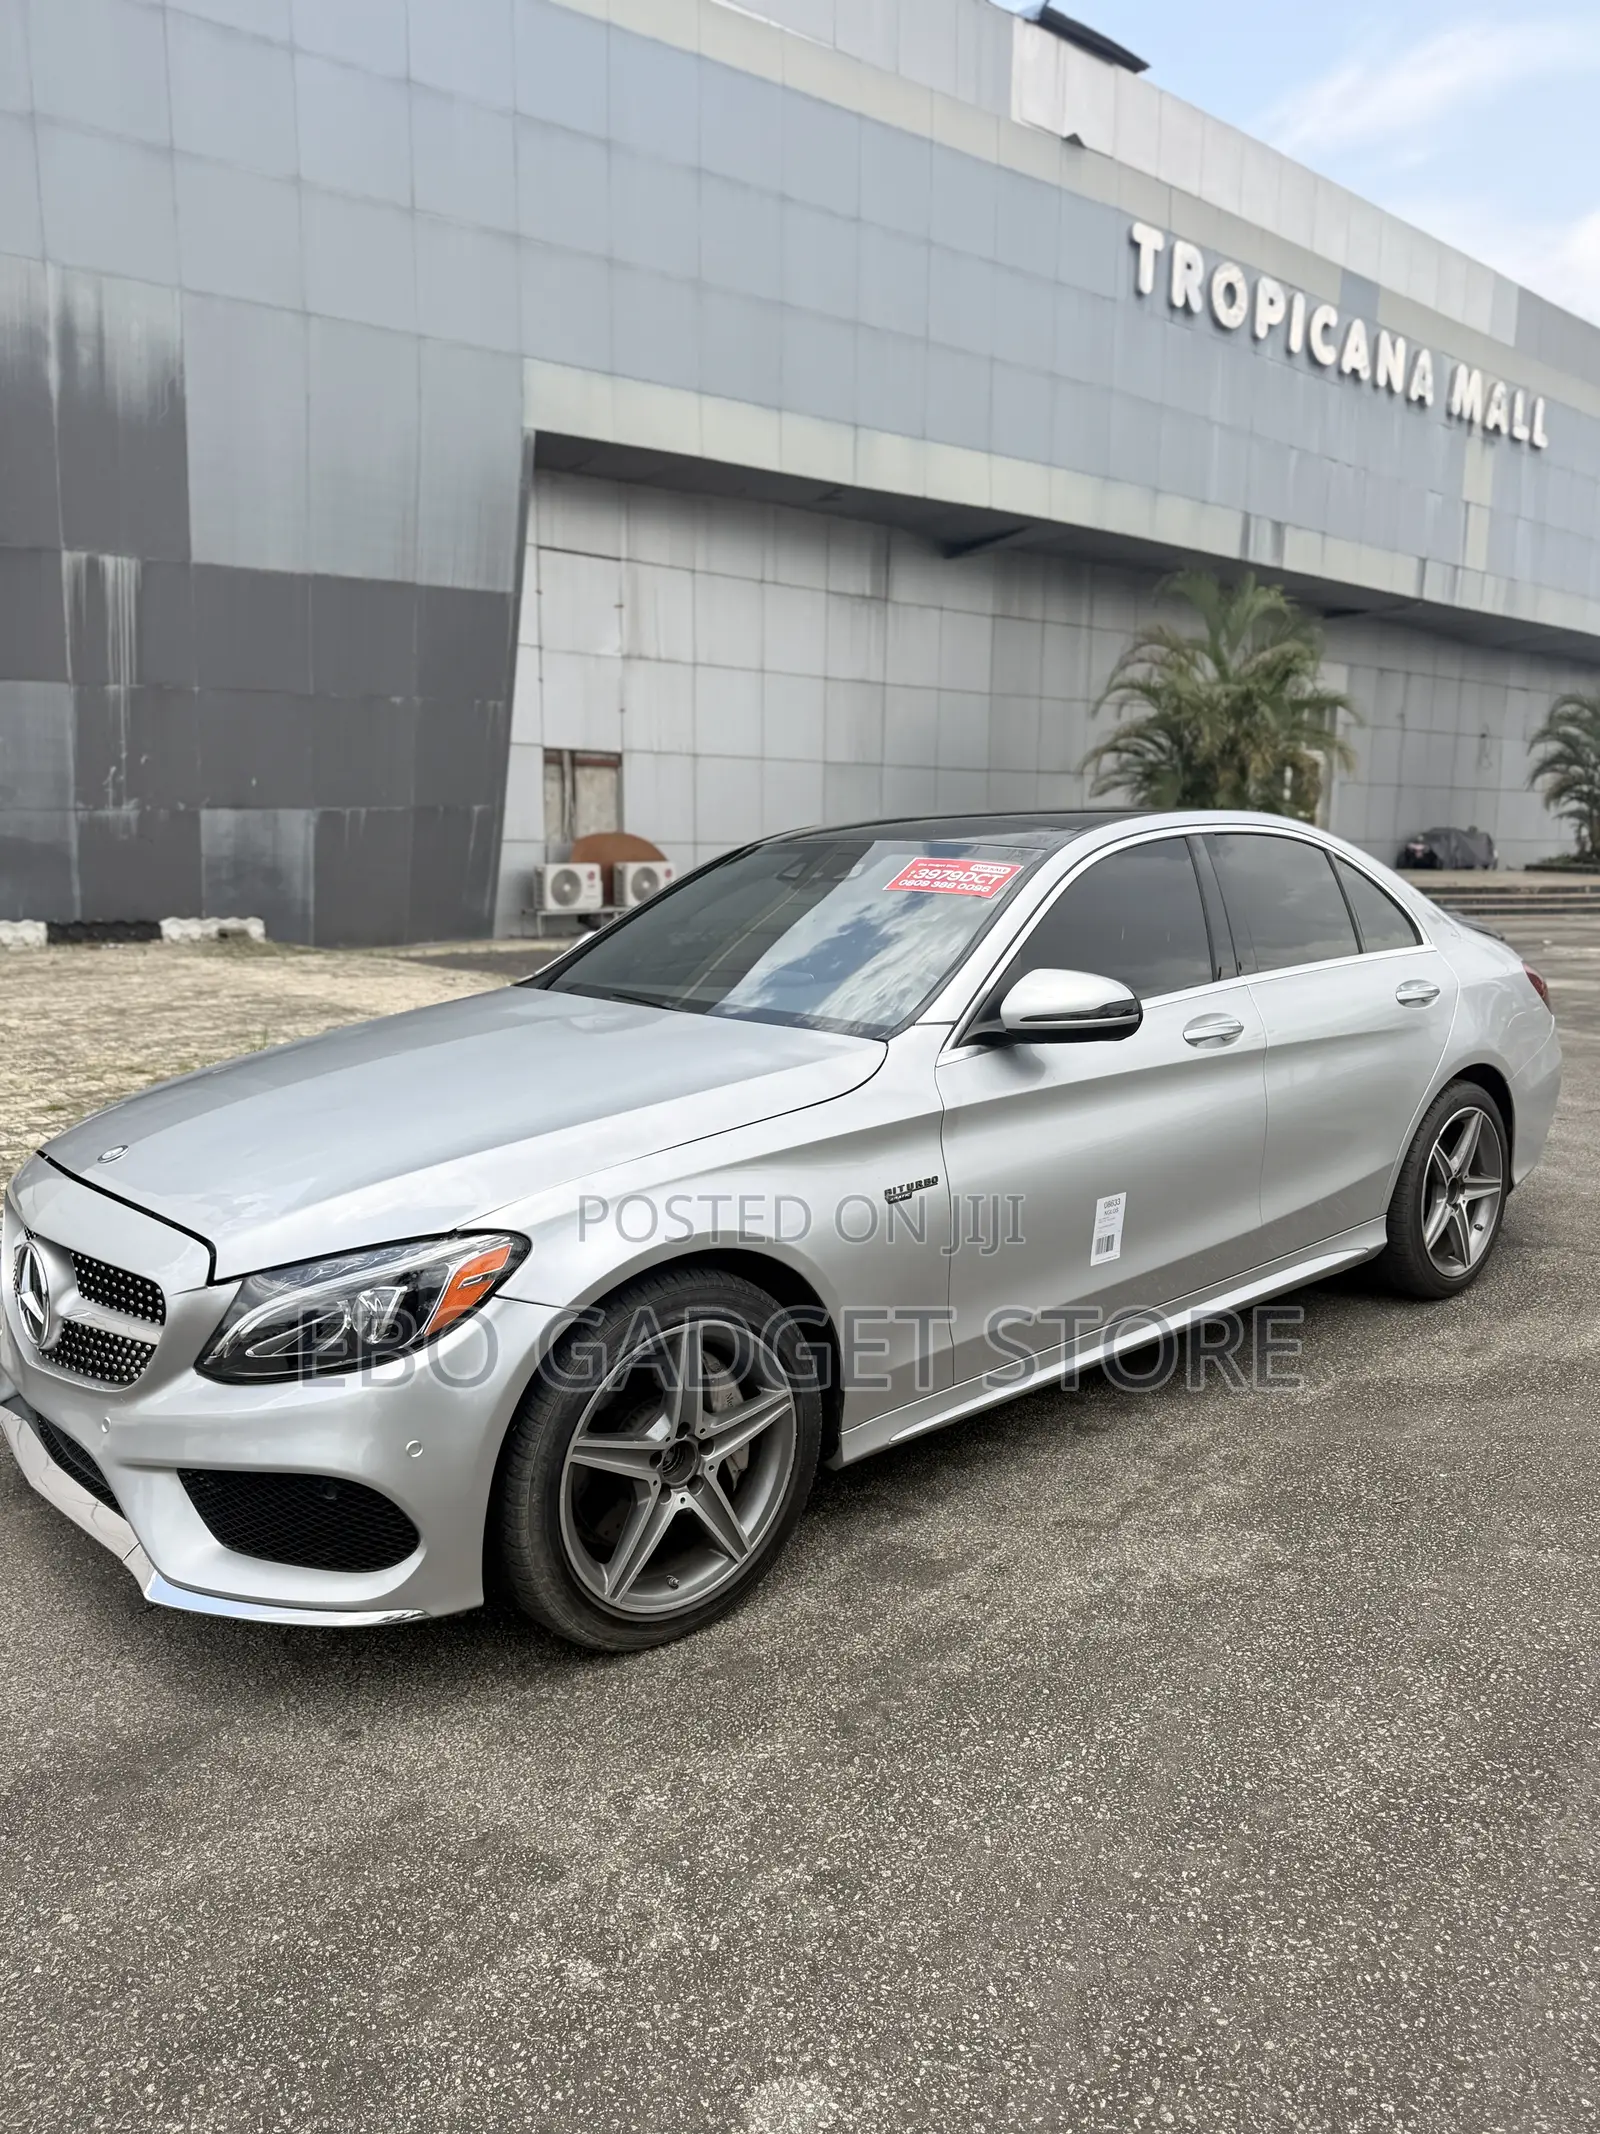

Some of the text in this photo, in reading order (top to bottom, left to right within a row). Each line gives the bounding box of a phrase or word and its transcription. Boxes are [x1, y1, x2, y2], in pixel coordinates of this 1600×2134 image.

[1131, 221, 1548, 449] TROPICANA MALL
[884, 1175, 939, 1197] BITURBO
